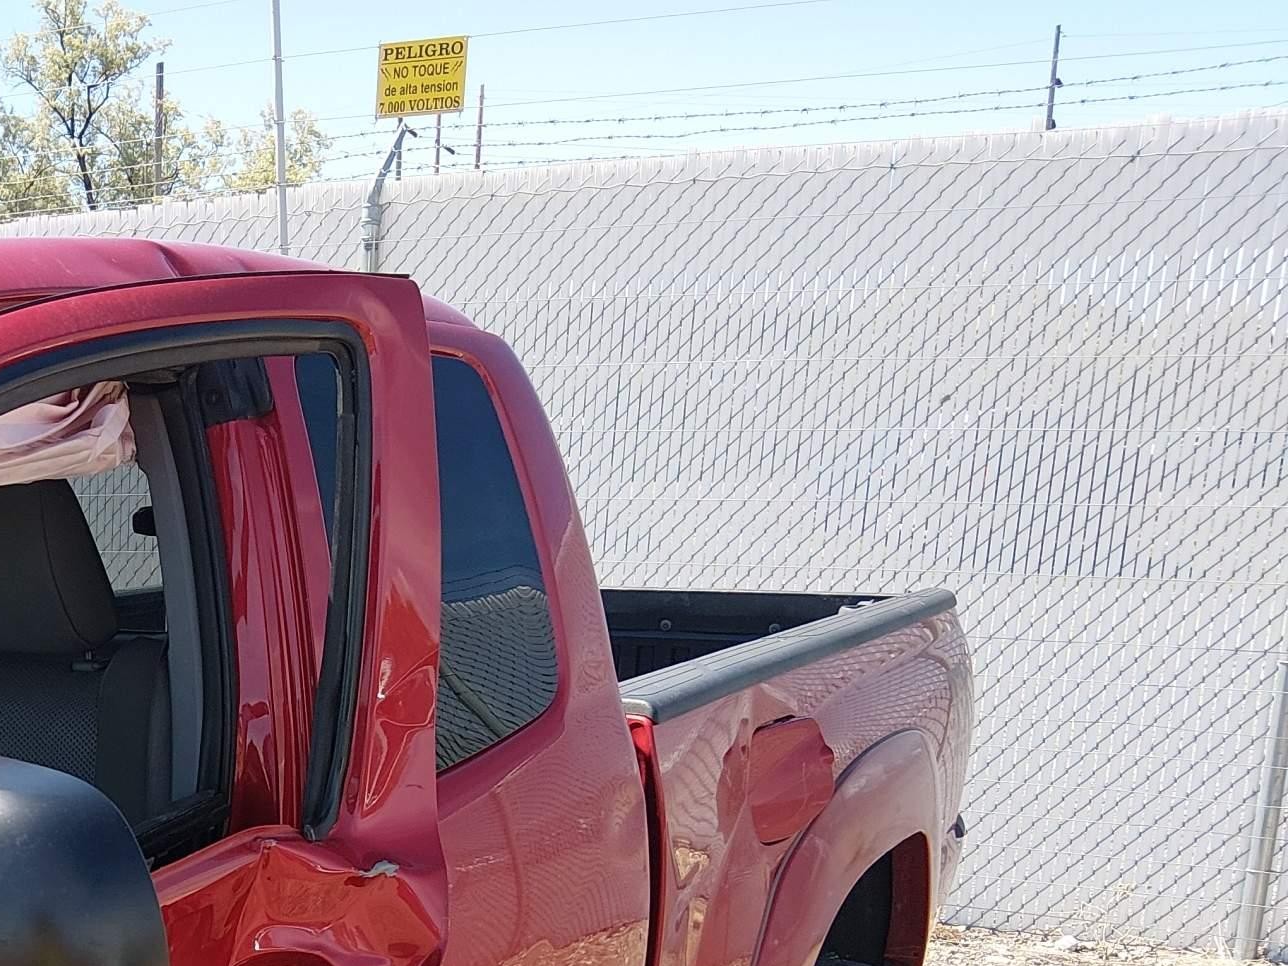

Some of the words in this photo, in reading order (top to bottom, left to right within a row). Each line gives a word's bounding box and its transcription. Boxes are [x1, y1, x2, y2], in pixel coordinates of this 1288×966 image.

[382, 41, 464, 61] PELIGRO
[393, 66, 409, 79] NO
[413, 62, 450, 77] TOQUE
[384, 85, 397, 97] de
[399, 82, 418, 95] alta
[421, 80, 458, 94] tension
[409, 96, 461, 111] VOLTIOS
